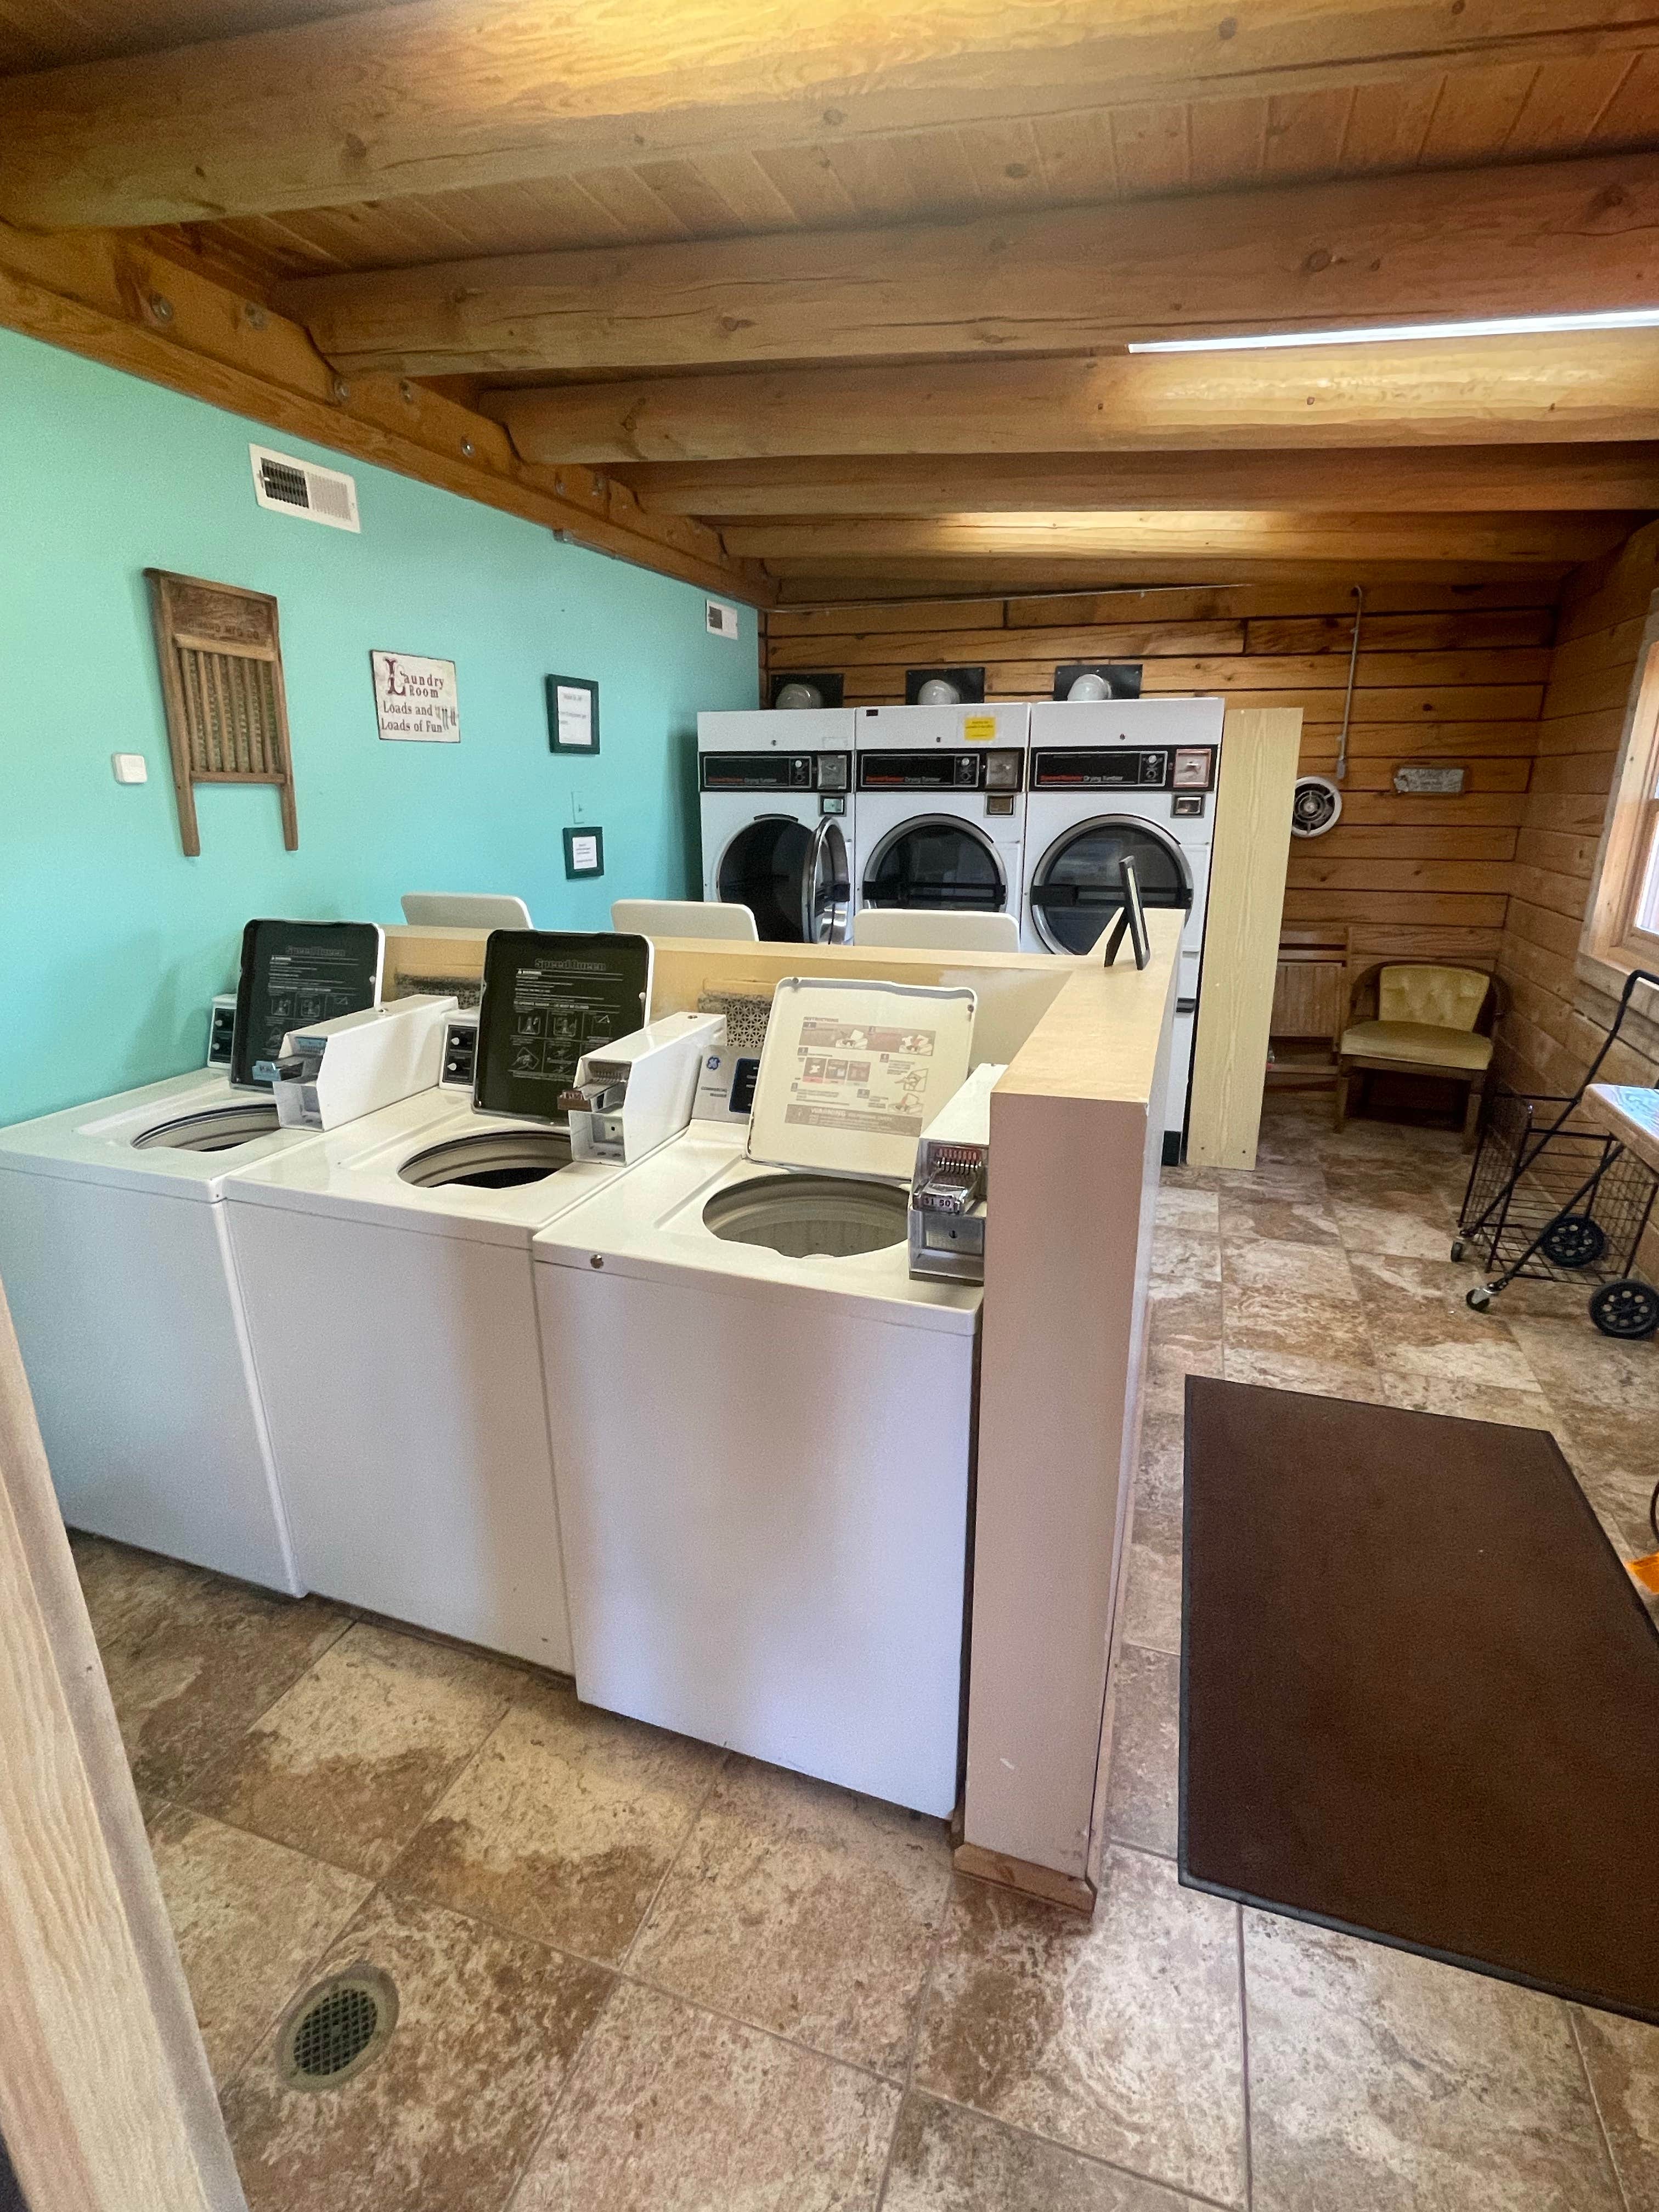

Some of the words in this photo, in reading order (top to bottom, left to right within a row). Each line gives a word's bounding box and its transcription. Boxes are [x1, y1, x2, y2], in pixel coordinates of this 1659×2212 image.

[383, 657, 444, 696] Laundry
[409, 685, 439, 698] Room
[383, 700, 412, 714] Loads
[415, 704, 433, 716] and
[381, 718, 411, 731] Loads
[414, 720, 423, 732] of
[426, 720, 443, 733] Fun
[534, 958, 571, 970] Speed
